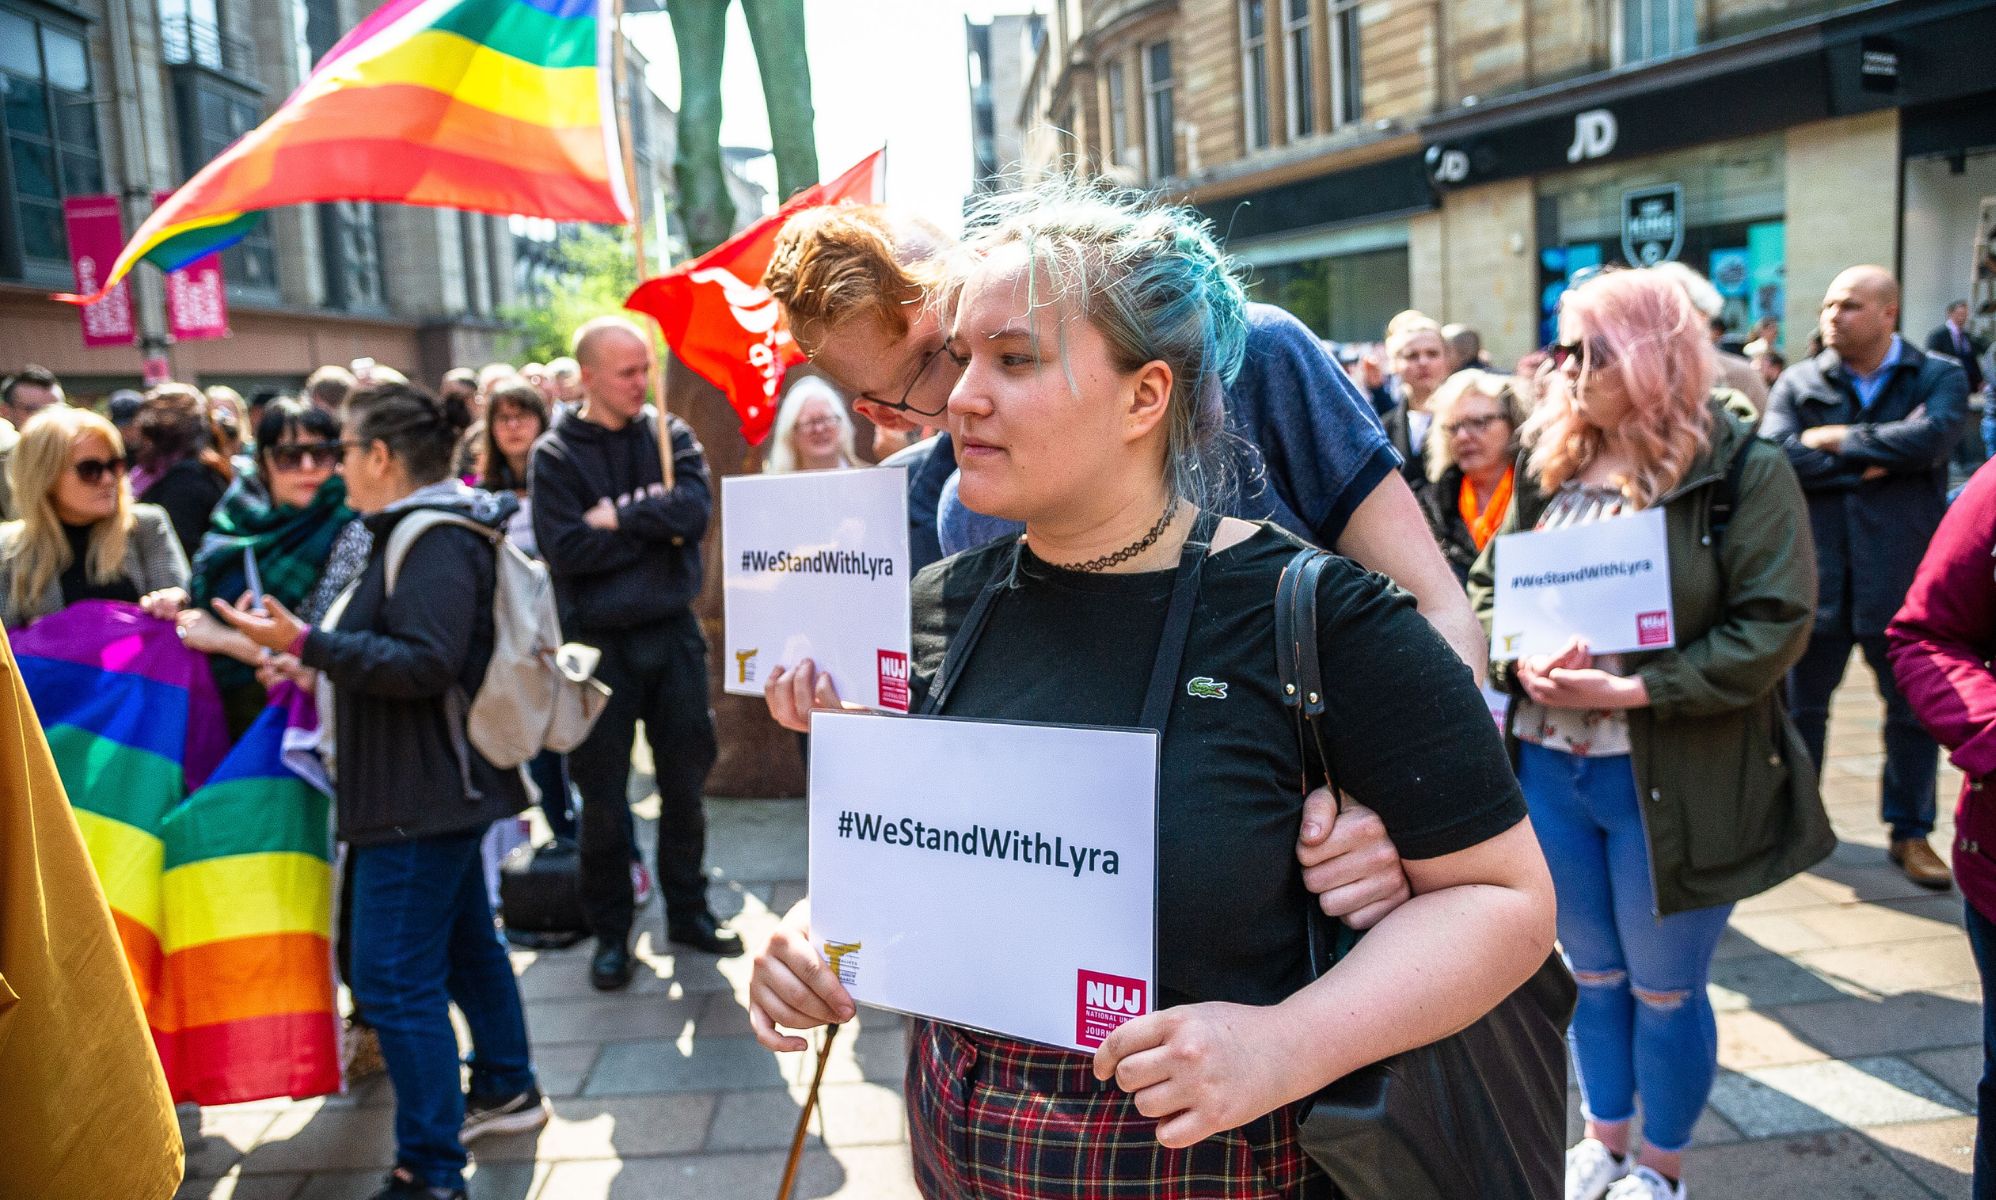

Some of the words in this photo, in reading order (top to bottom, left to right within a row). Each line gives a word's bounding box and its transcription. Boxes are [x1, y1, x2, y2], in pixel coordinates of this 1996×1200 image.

[1567, 109, 1618, 164] JD
[1434, 150, 1470, 182] JD
[742, 550, 893, 581] #WeStandWithLyra
[1511, 558, 1653, 588] #WeStandWithLyra
[881, 656, 906, 679] NUJ
[838, 810, 1120, 878] #WeStandWithLyra
[1086, 980, 1141, 1014] NUJ
[1086, 1010, 1117, 1022] NATIONAL
